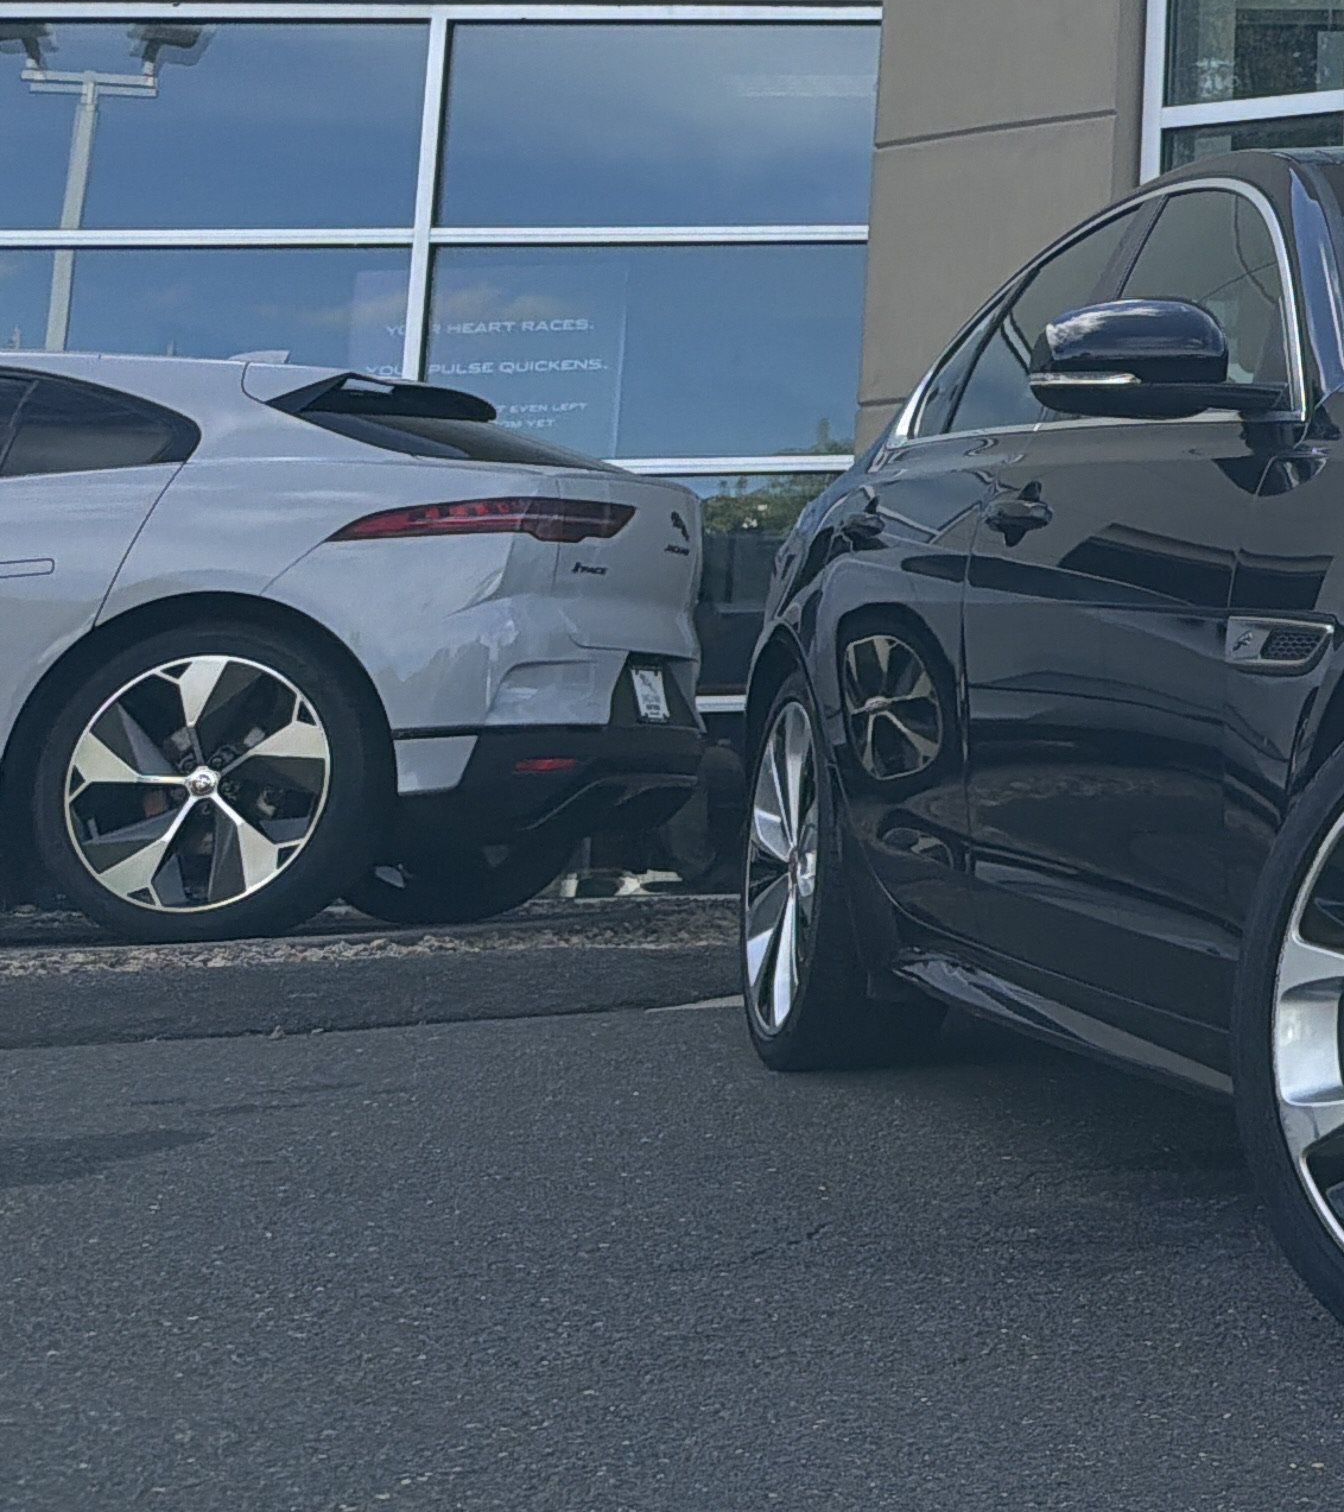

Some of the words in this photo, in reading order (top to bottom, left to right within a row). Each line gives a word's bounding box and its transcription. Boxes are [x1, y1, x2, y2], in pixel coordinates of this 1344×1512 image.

[447, 321, 516, 335] HEART
[521, 319, 595, 332] RACES.
[429, 362, 494, 374] PULSE
[499, 359, 608, 374] QUICKENS.
